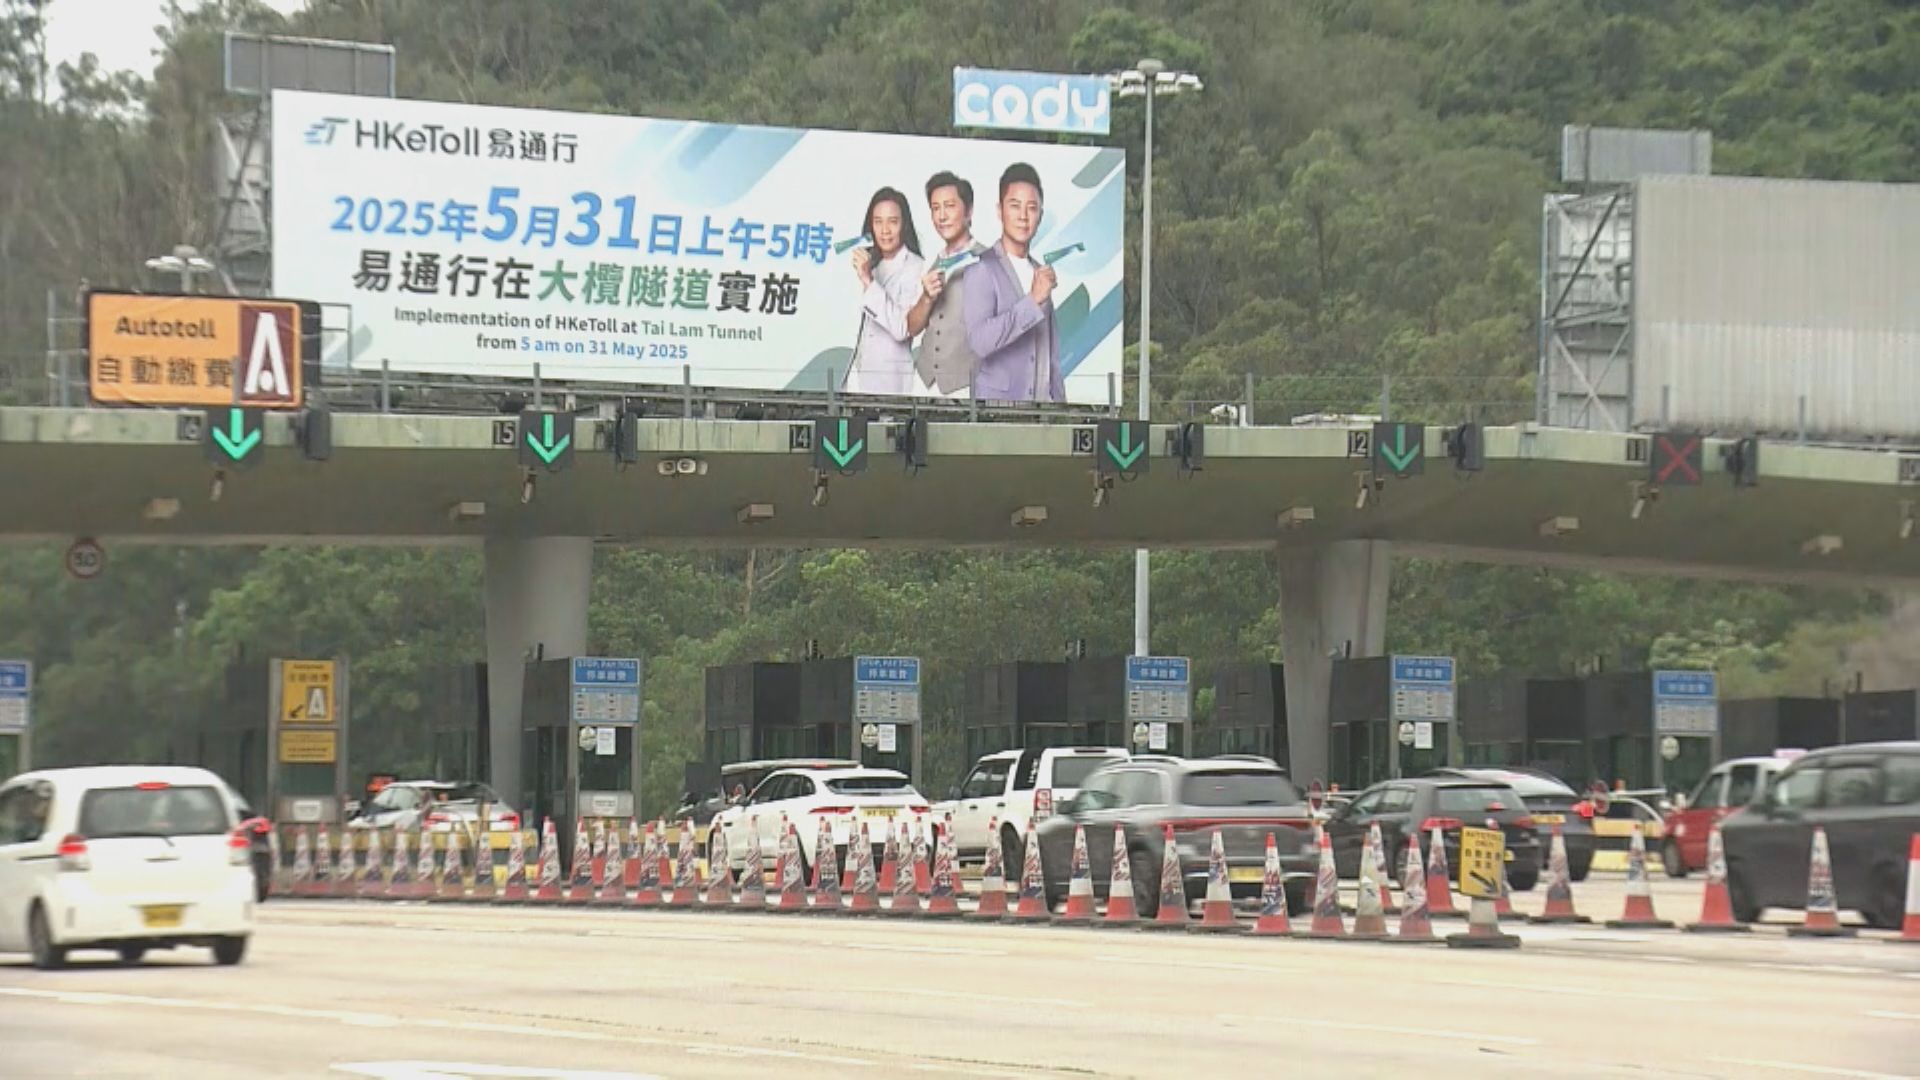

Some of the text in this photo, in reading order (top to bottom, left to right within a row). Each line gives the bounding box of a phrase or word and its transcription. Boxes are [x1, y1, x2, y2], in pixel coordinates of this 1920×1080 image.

[958, 81, 1107, 129] cody
[355, 118, 479, 157] HKeToll
[488, 128, 578, 163] 易通行
[330, 185, 834, 264] 2025年5月31日上午5時
[353, 249, 800, 315] 易通行在大欖隧道實施
[115, 316, 217, 339] Autotoll
[394, 306, 762, 341] Implementation of HKeToll at Tai Lam Tunnel
[476, 333, 688, 359] from 5 am on 31 May 2025
[97, 355, 233, 388] 自動繳費
[496, 421, 515, 444] 15
[792, 425, 810, 448] 14
[1075, 429, 1093, 451] 13
[1351, 431, 1368, 453] 12
